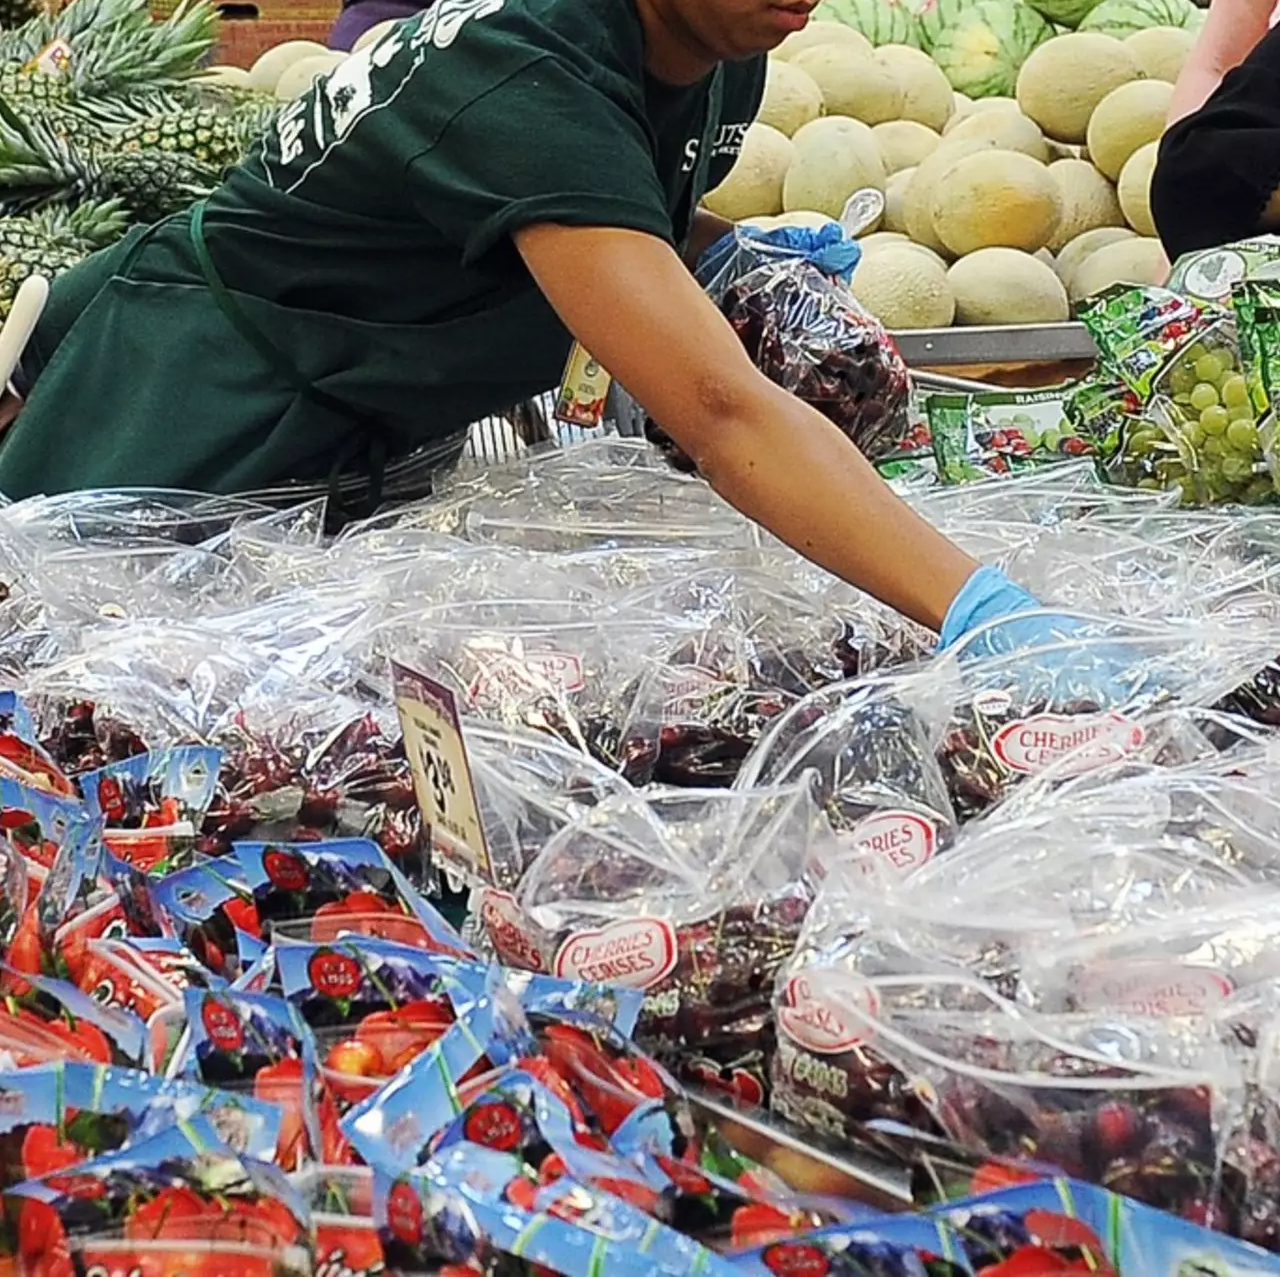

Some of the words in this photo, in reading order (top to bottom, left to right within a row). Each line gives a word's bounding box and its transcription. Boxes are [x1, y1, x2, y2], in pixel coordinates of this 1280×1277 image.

[859, 823, 914, 855] RRIES
[569, 928, 654, 966] CHERRIES
[576, 952, 656, 984] CERISES
